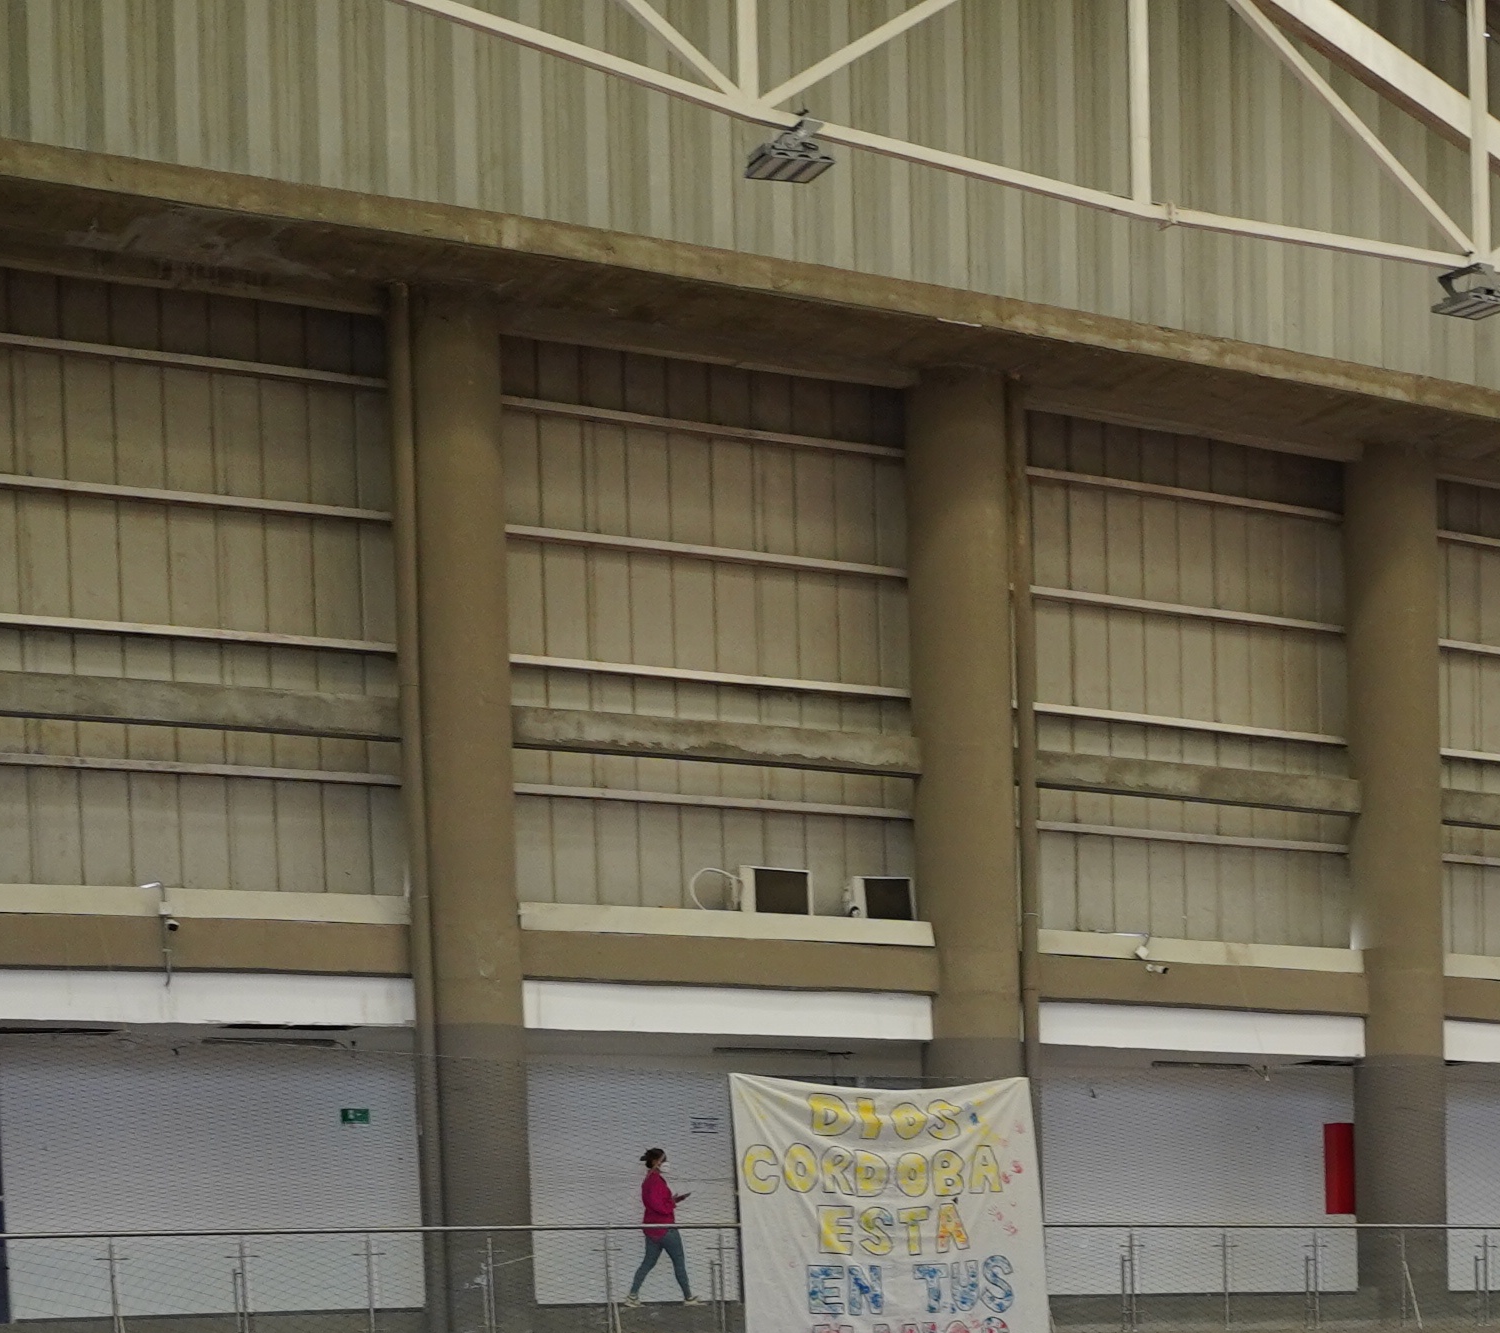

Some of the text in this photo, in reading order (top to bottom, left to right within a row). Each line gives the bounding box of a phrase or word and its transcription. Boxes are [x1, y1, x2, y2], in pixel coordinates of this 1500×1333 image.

[808, 1093, 962, 1140] DIOS
[742, 1142, 1003, 1197] CORDOBA
[807, 1255, 1014, 1316] EN TUS
